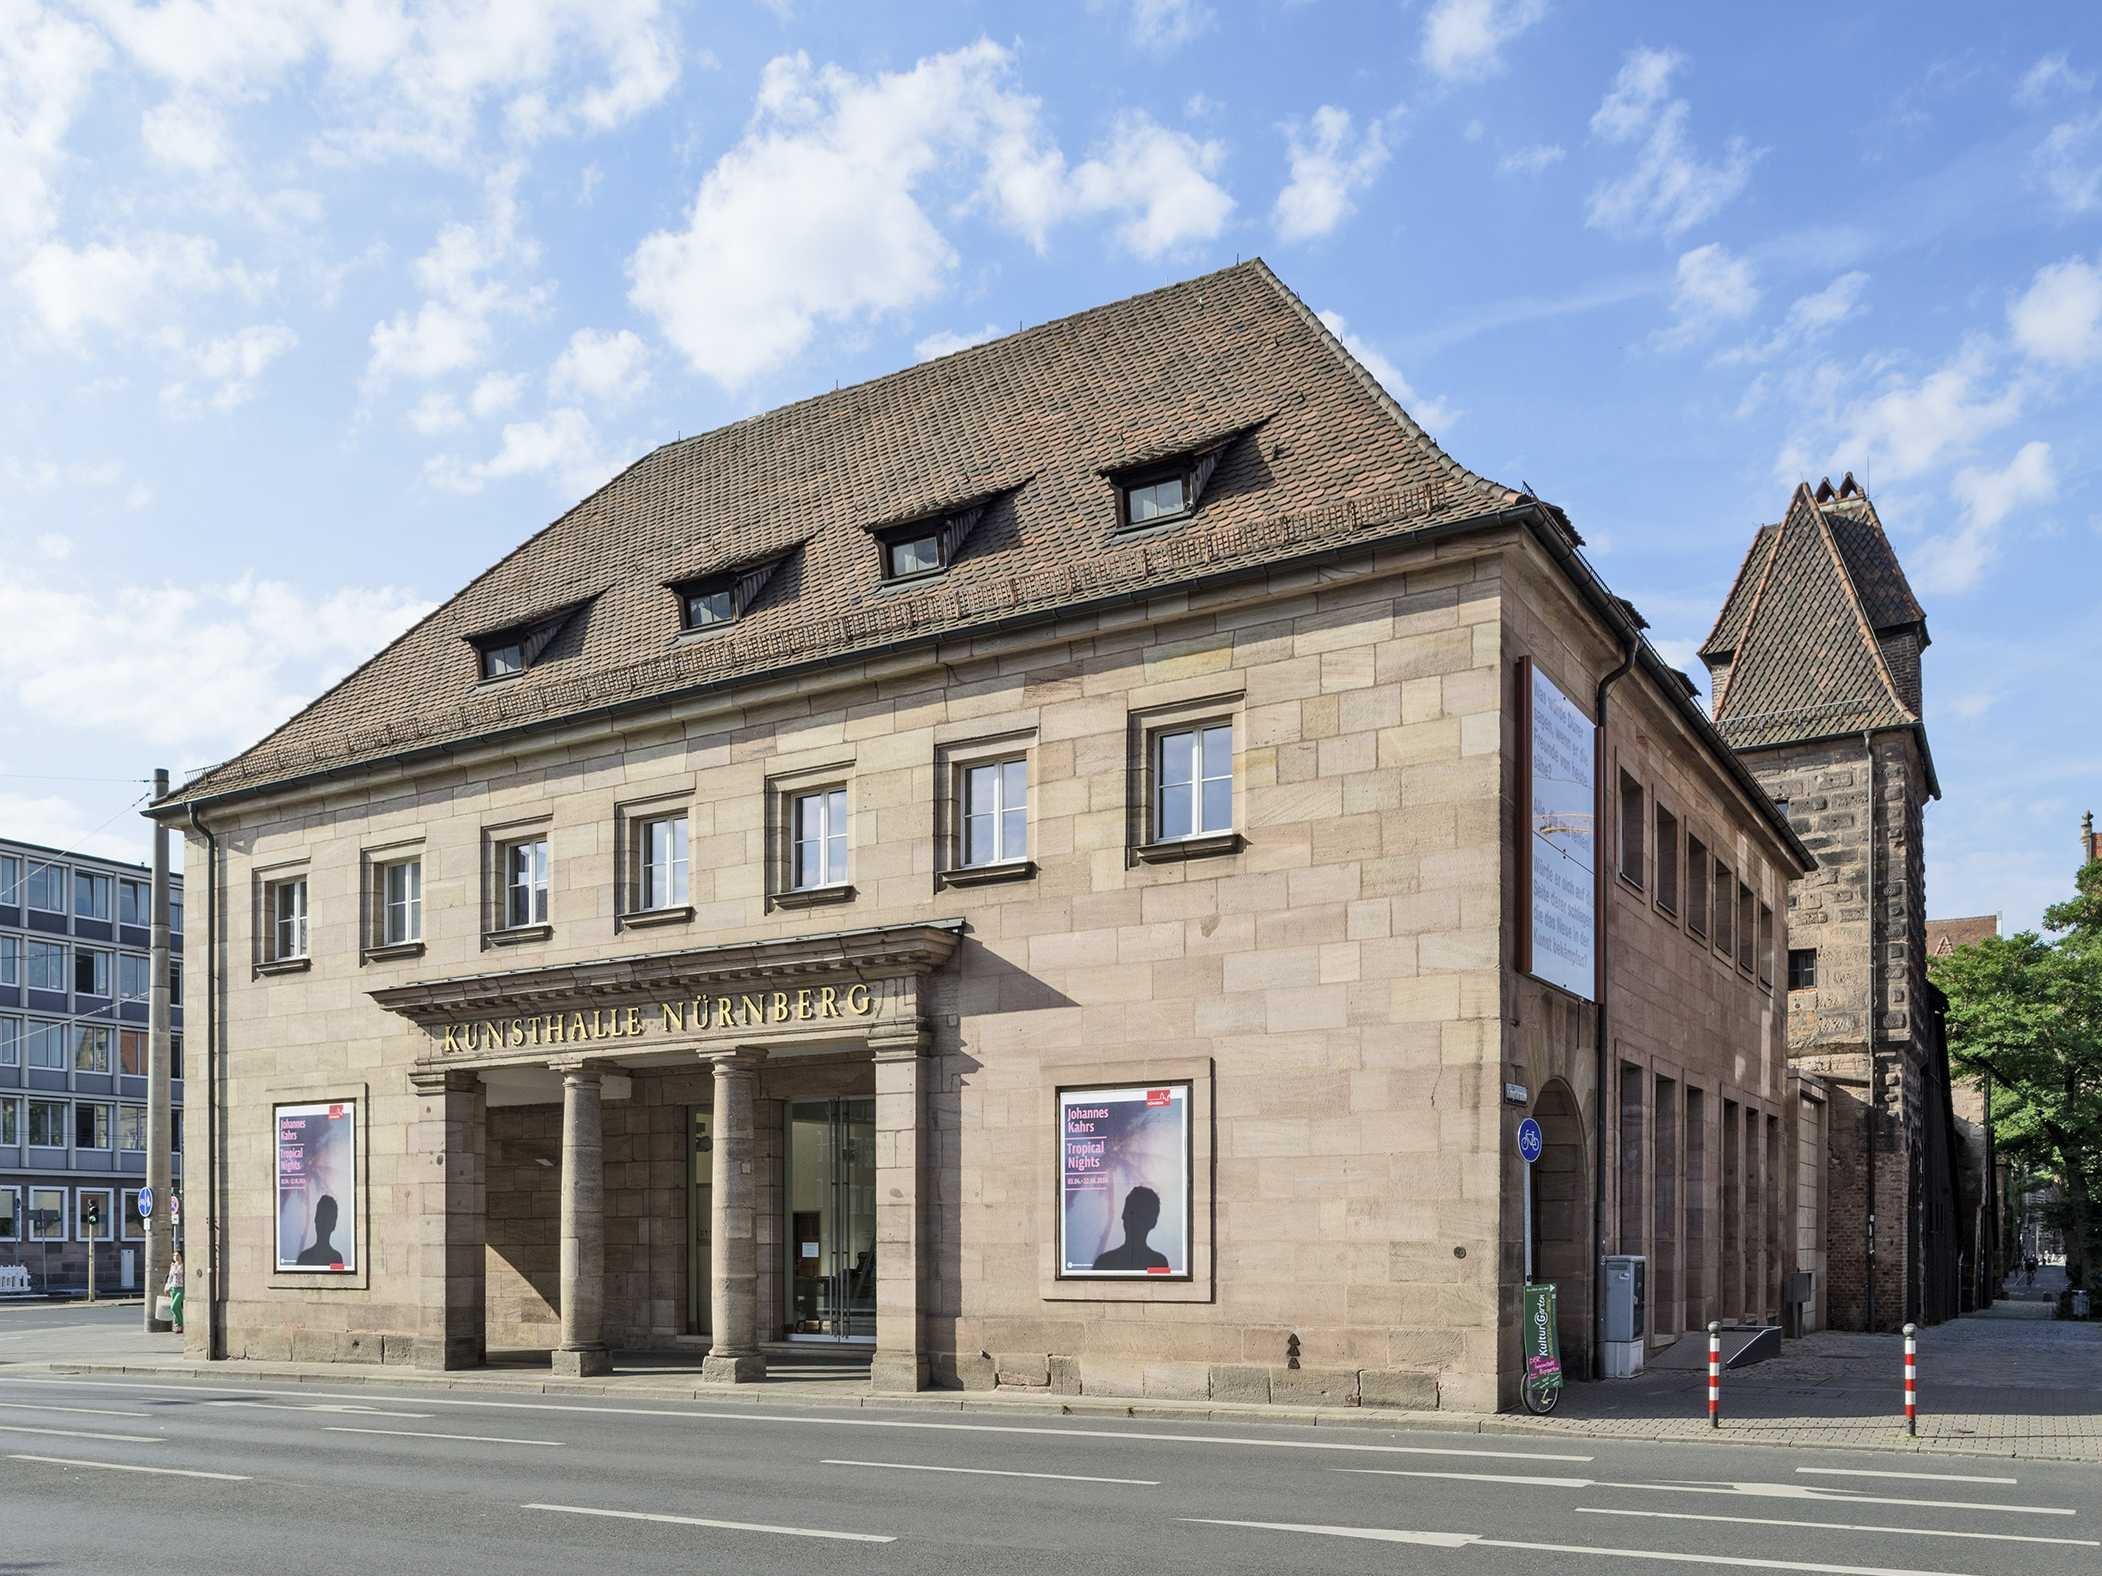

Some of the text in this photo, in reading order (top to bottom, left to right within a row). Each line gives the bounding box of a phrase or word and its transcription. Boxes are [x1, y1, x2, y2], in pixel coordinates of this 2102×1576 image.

[444, 984, 871, 1052] KUNSTHALLE NÜRNBERG
[1067, 1107, 1109, 1121] Johannes
[1068, 1120, 1095, 1133] Kahrs
[1067, 1140, 1104, 1156] Tropical
[1068, 1156, 1100, 1171] Nights
